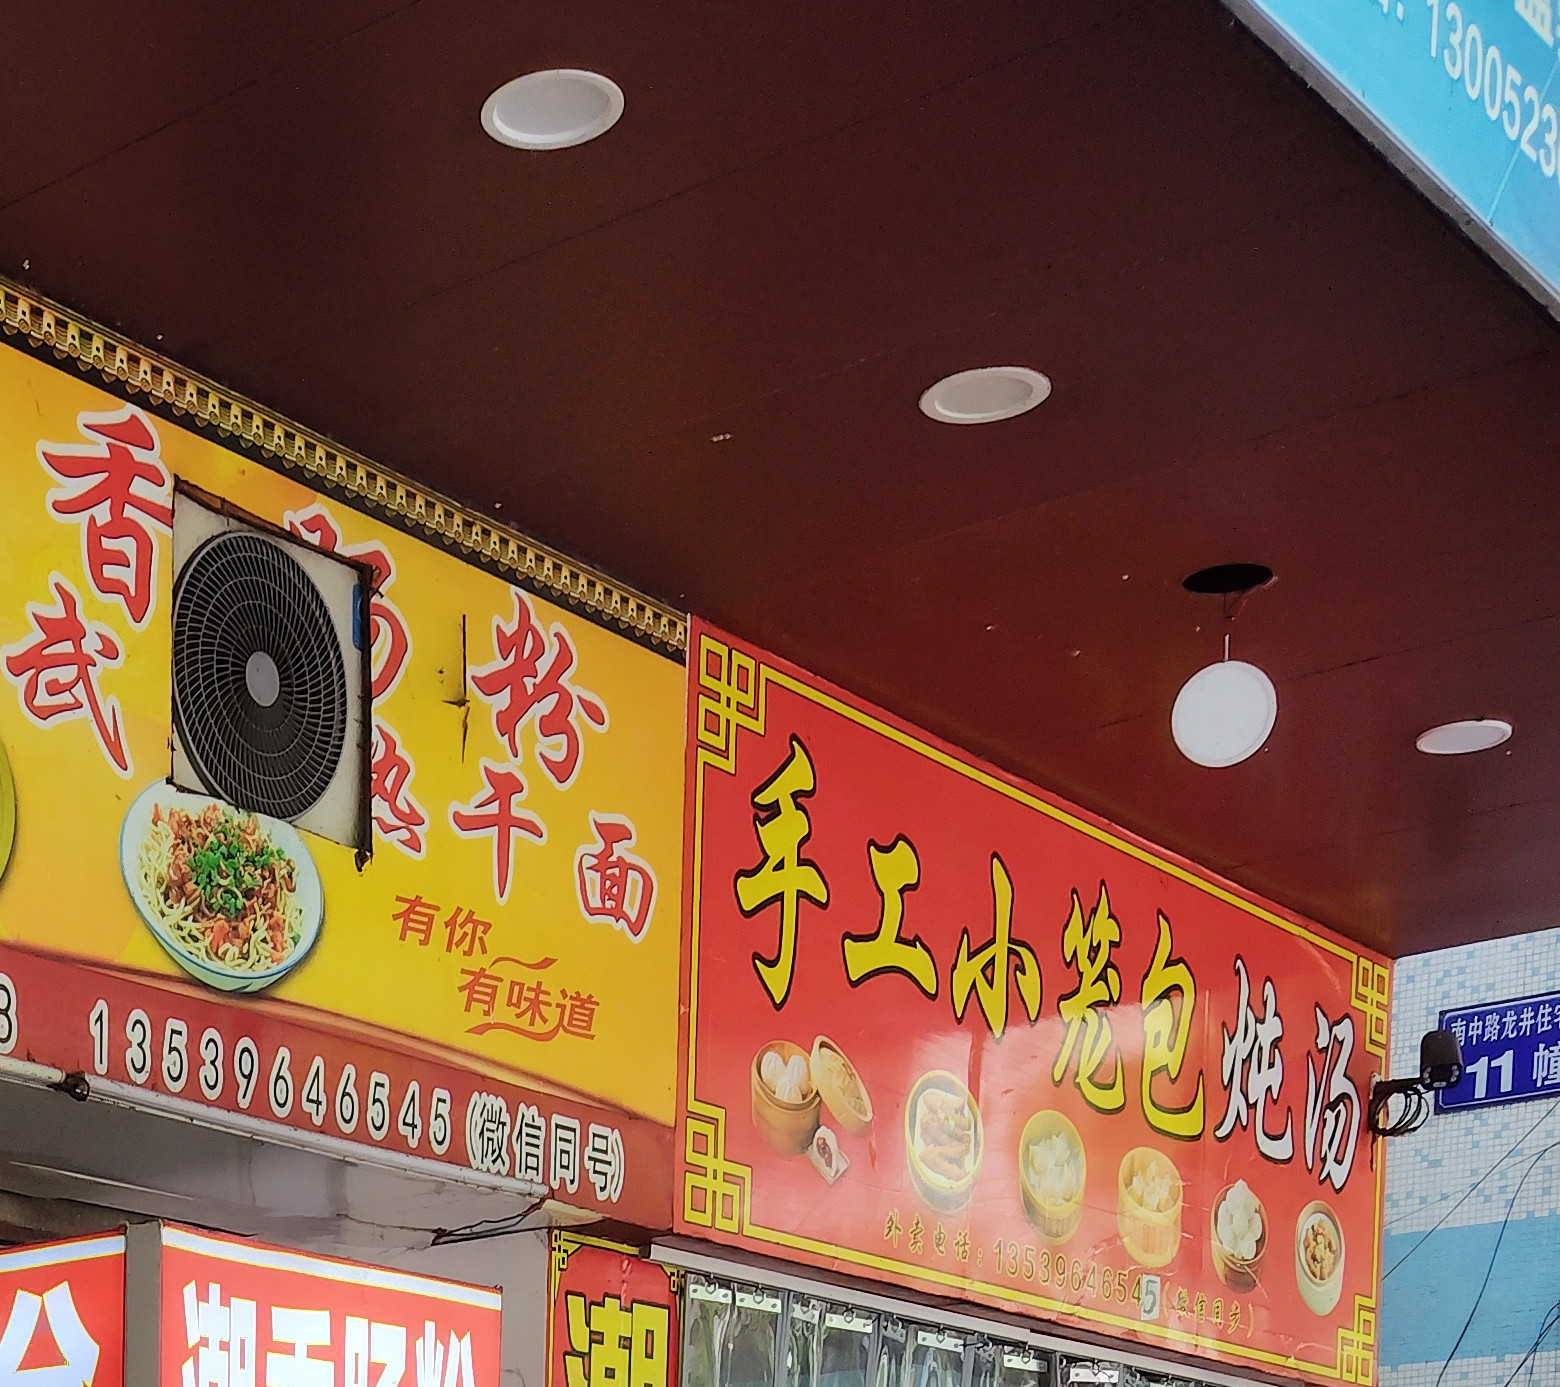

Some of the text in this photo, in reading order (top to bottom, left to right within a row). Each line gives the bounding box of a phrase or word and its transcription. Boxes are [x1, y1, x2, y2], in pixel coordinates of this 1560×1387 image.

[1428, 0, 1560, 182] 1300523
[392, 895, 493, 958] 有你
[456, 966, 600, 1041] 有味道
[1466, 1050, 1514, 1098] 11
